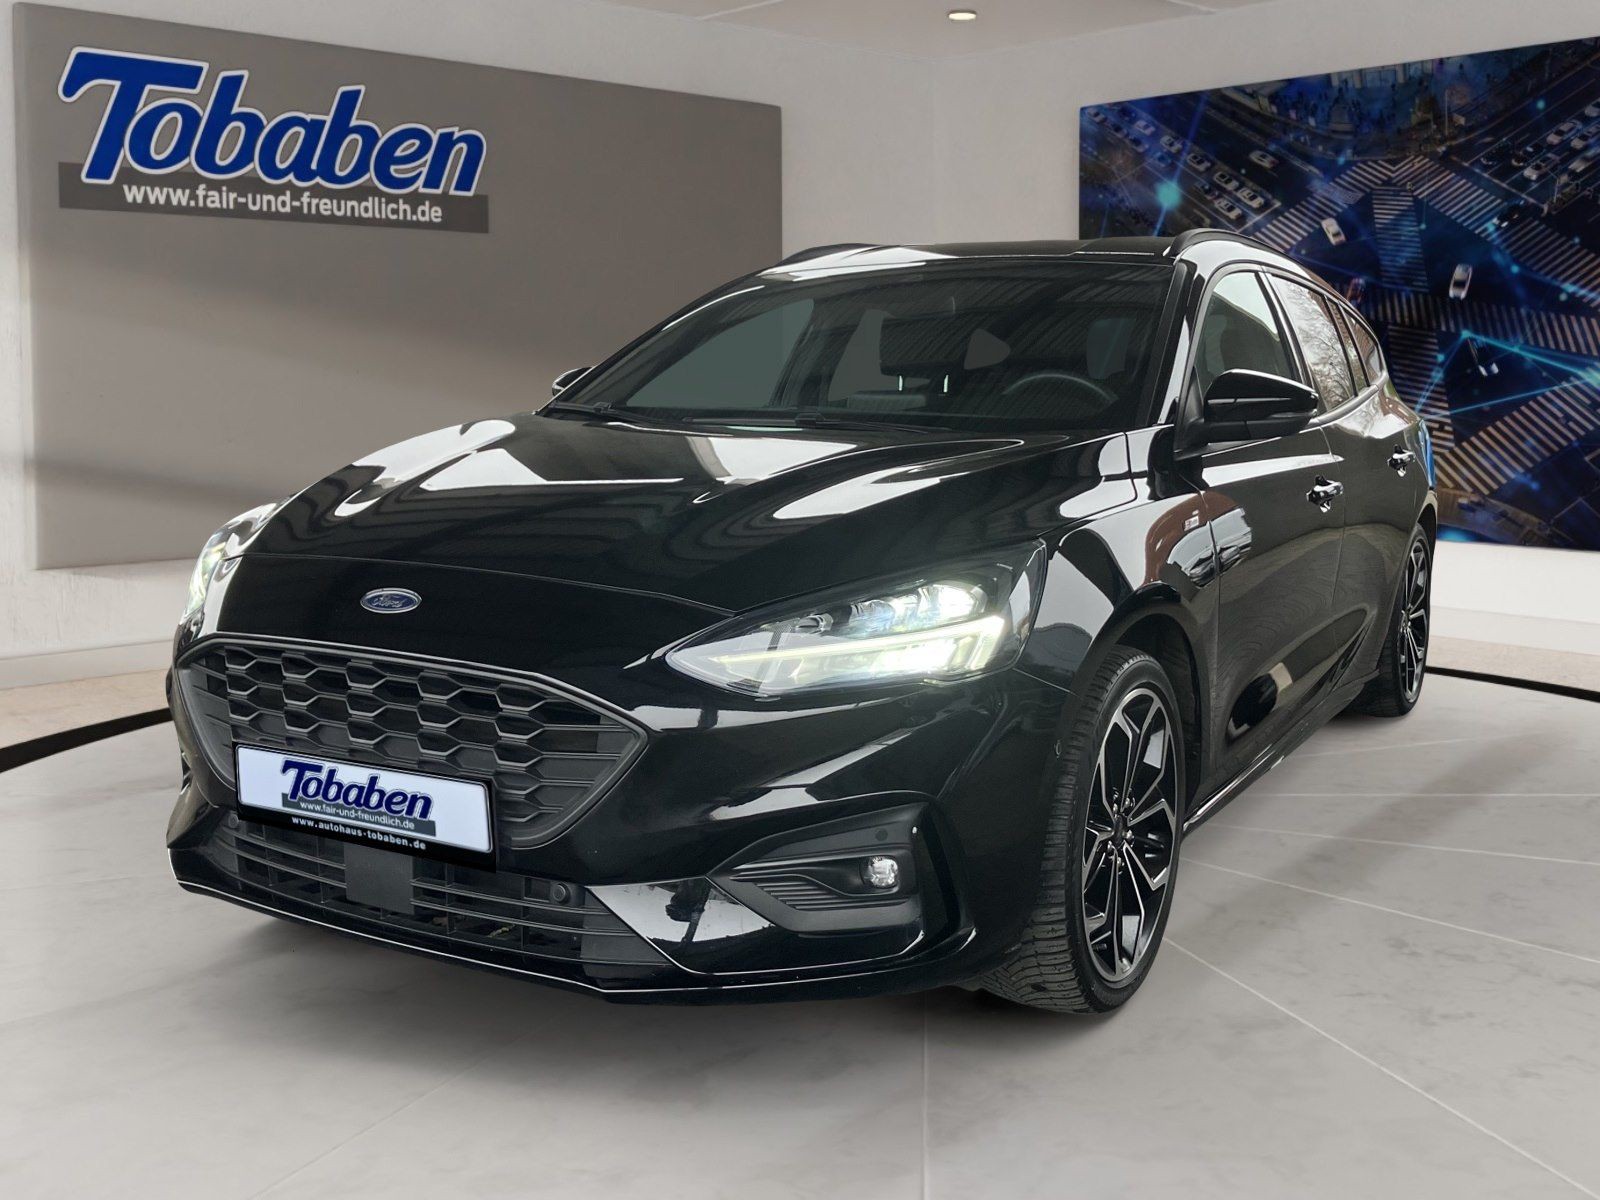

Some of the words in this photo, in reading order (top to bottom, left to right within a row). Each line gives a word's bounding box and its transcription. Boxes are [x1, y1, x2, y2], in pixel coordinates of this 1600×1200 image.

[58, 46, 487, 197] Tobaben
[123, 183, 443, 223] www.fair-und-freundlich.de
[371, 593, 408, 608] Ford
[281, 759, 434, 820] Tobaben
[291, 816, 427, 850] www.autohaus-tobaben.de
[300, 801, 416, 830] www.fair-und-freundlich.de
